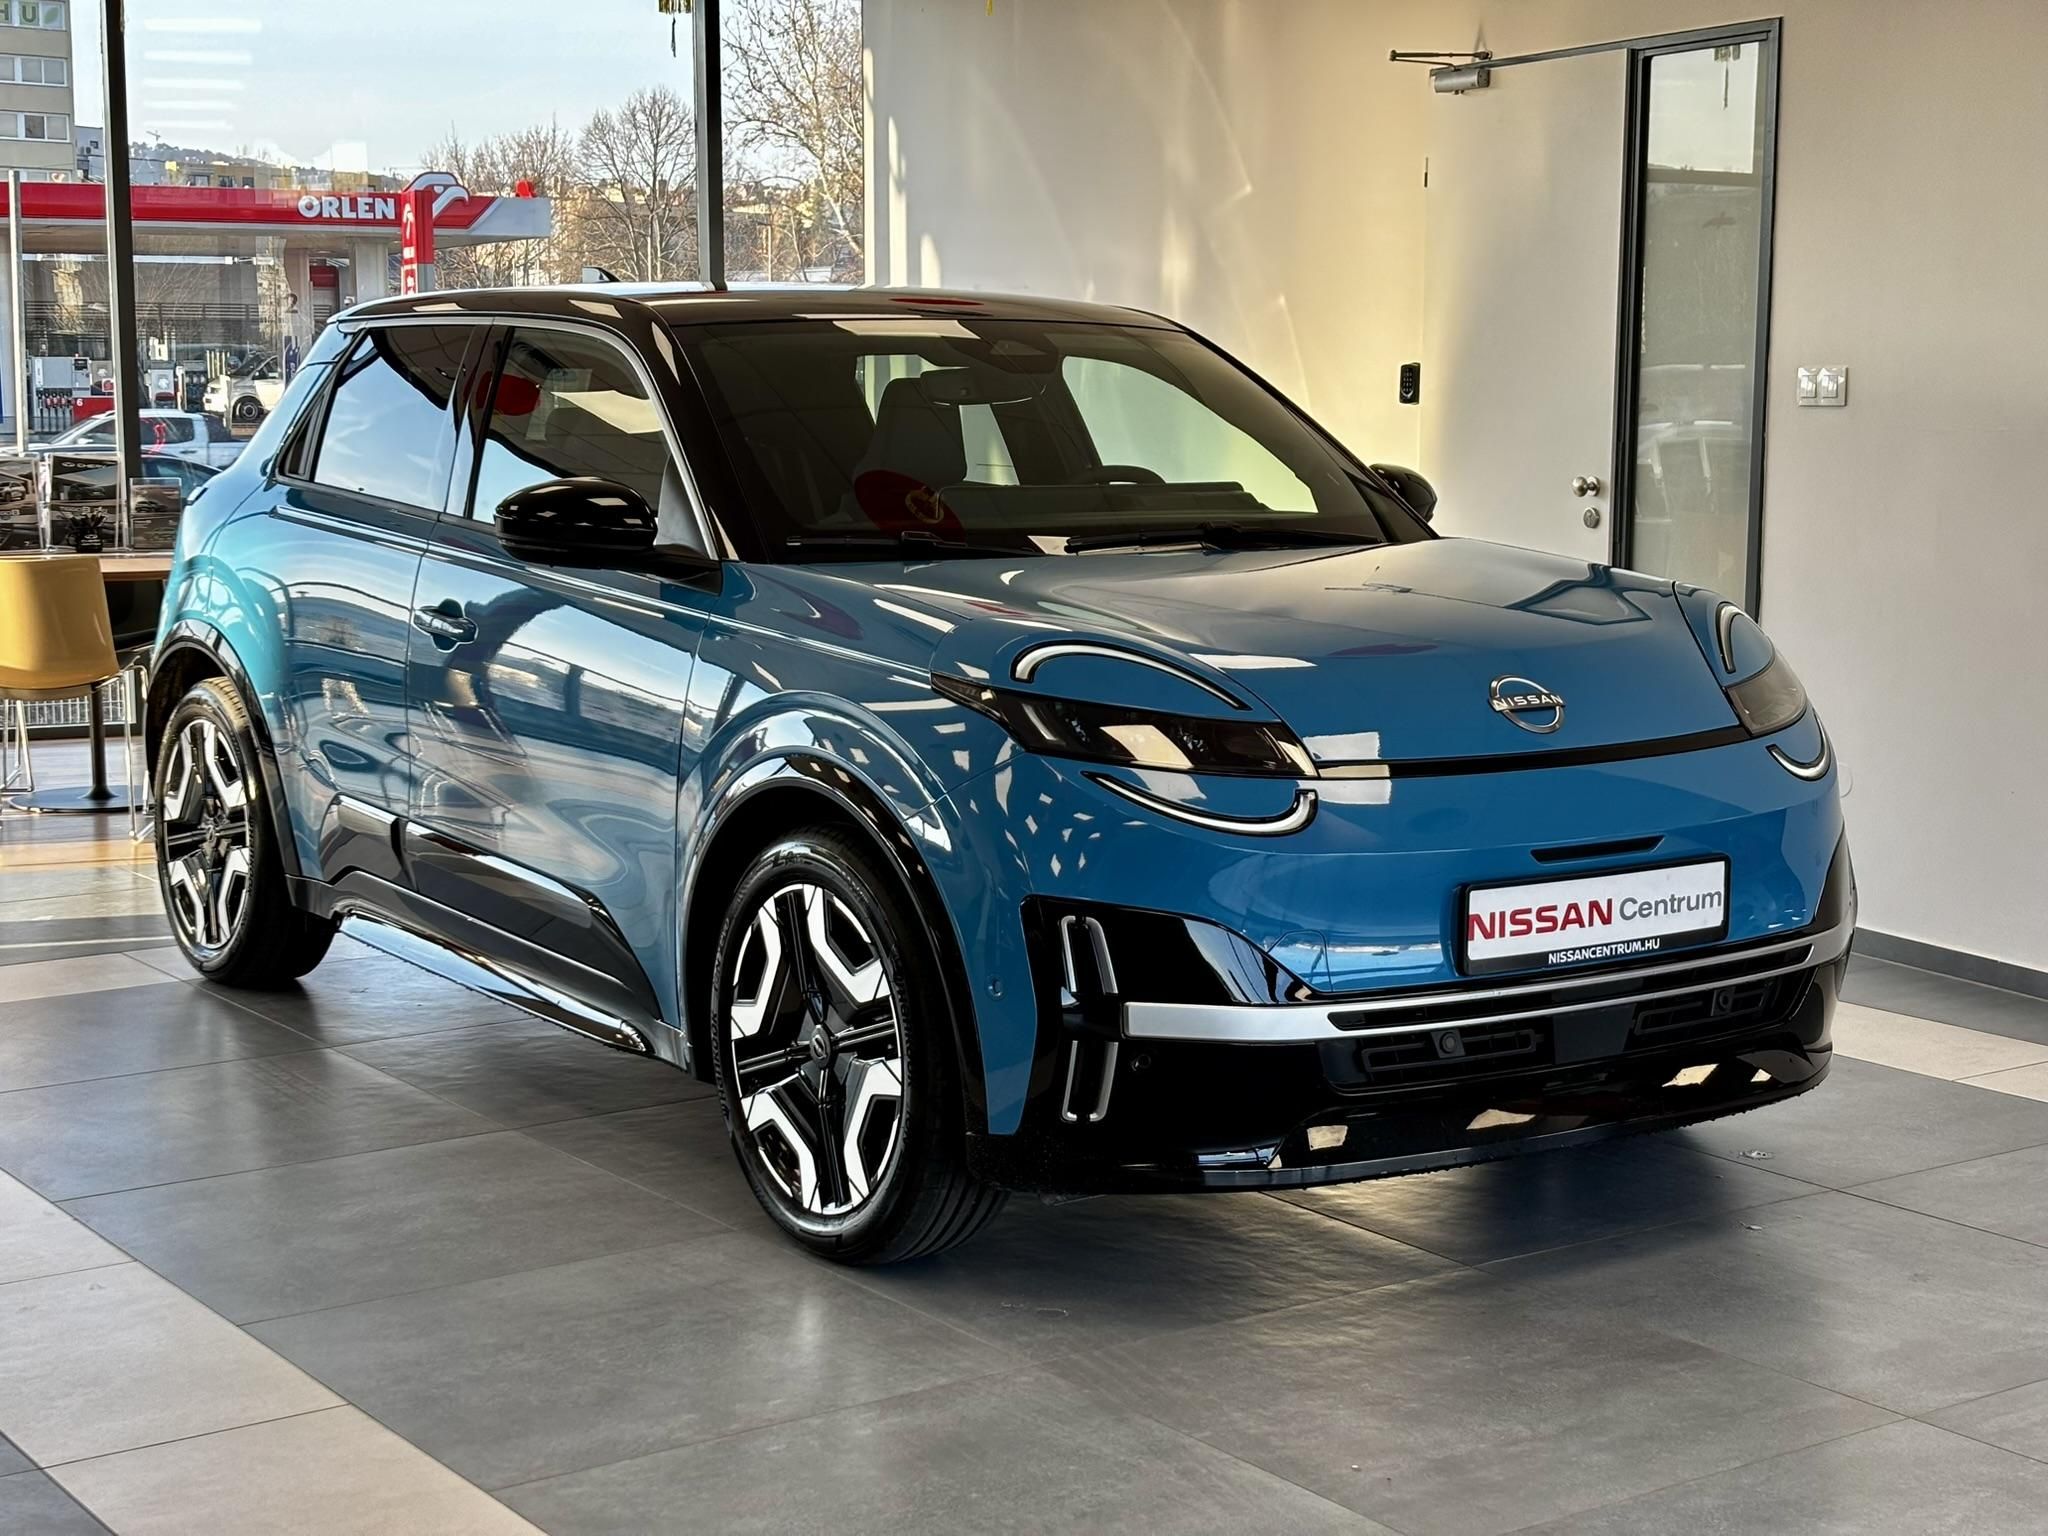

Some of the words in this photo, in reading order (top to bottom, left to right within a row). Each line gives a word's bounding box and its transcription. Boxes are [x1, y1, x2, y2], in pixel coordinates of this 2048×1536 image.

[298, 195, 396, 219] ORLEN
[1493, 694, 1563, 710] NISSAN
[1467, 898, 1613, 941] NISSAN
[1619, 890, 1722, 921] Centrum
[1548, 937, 1661, 964] NISSANCENTRUM.HU
